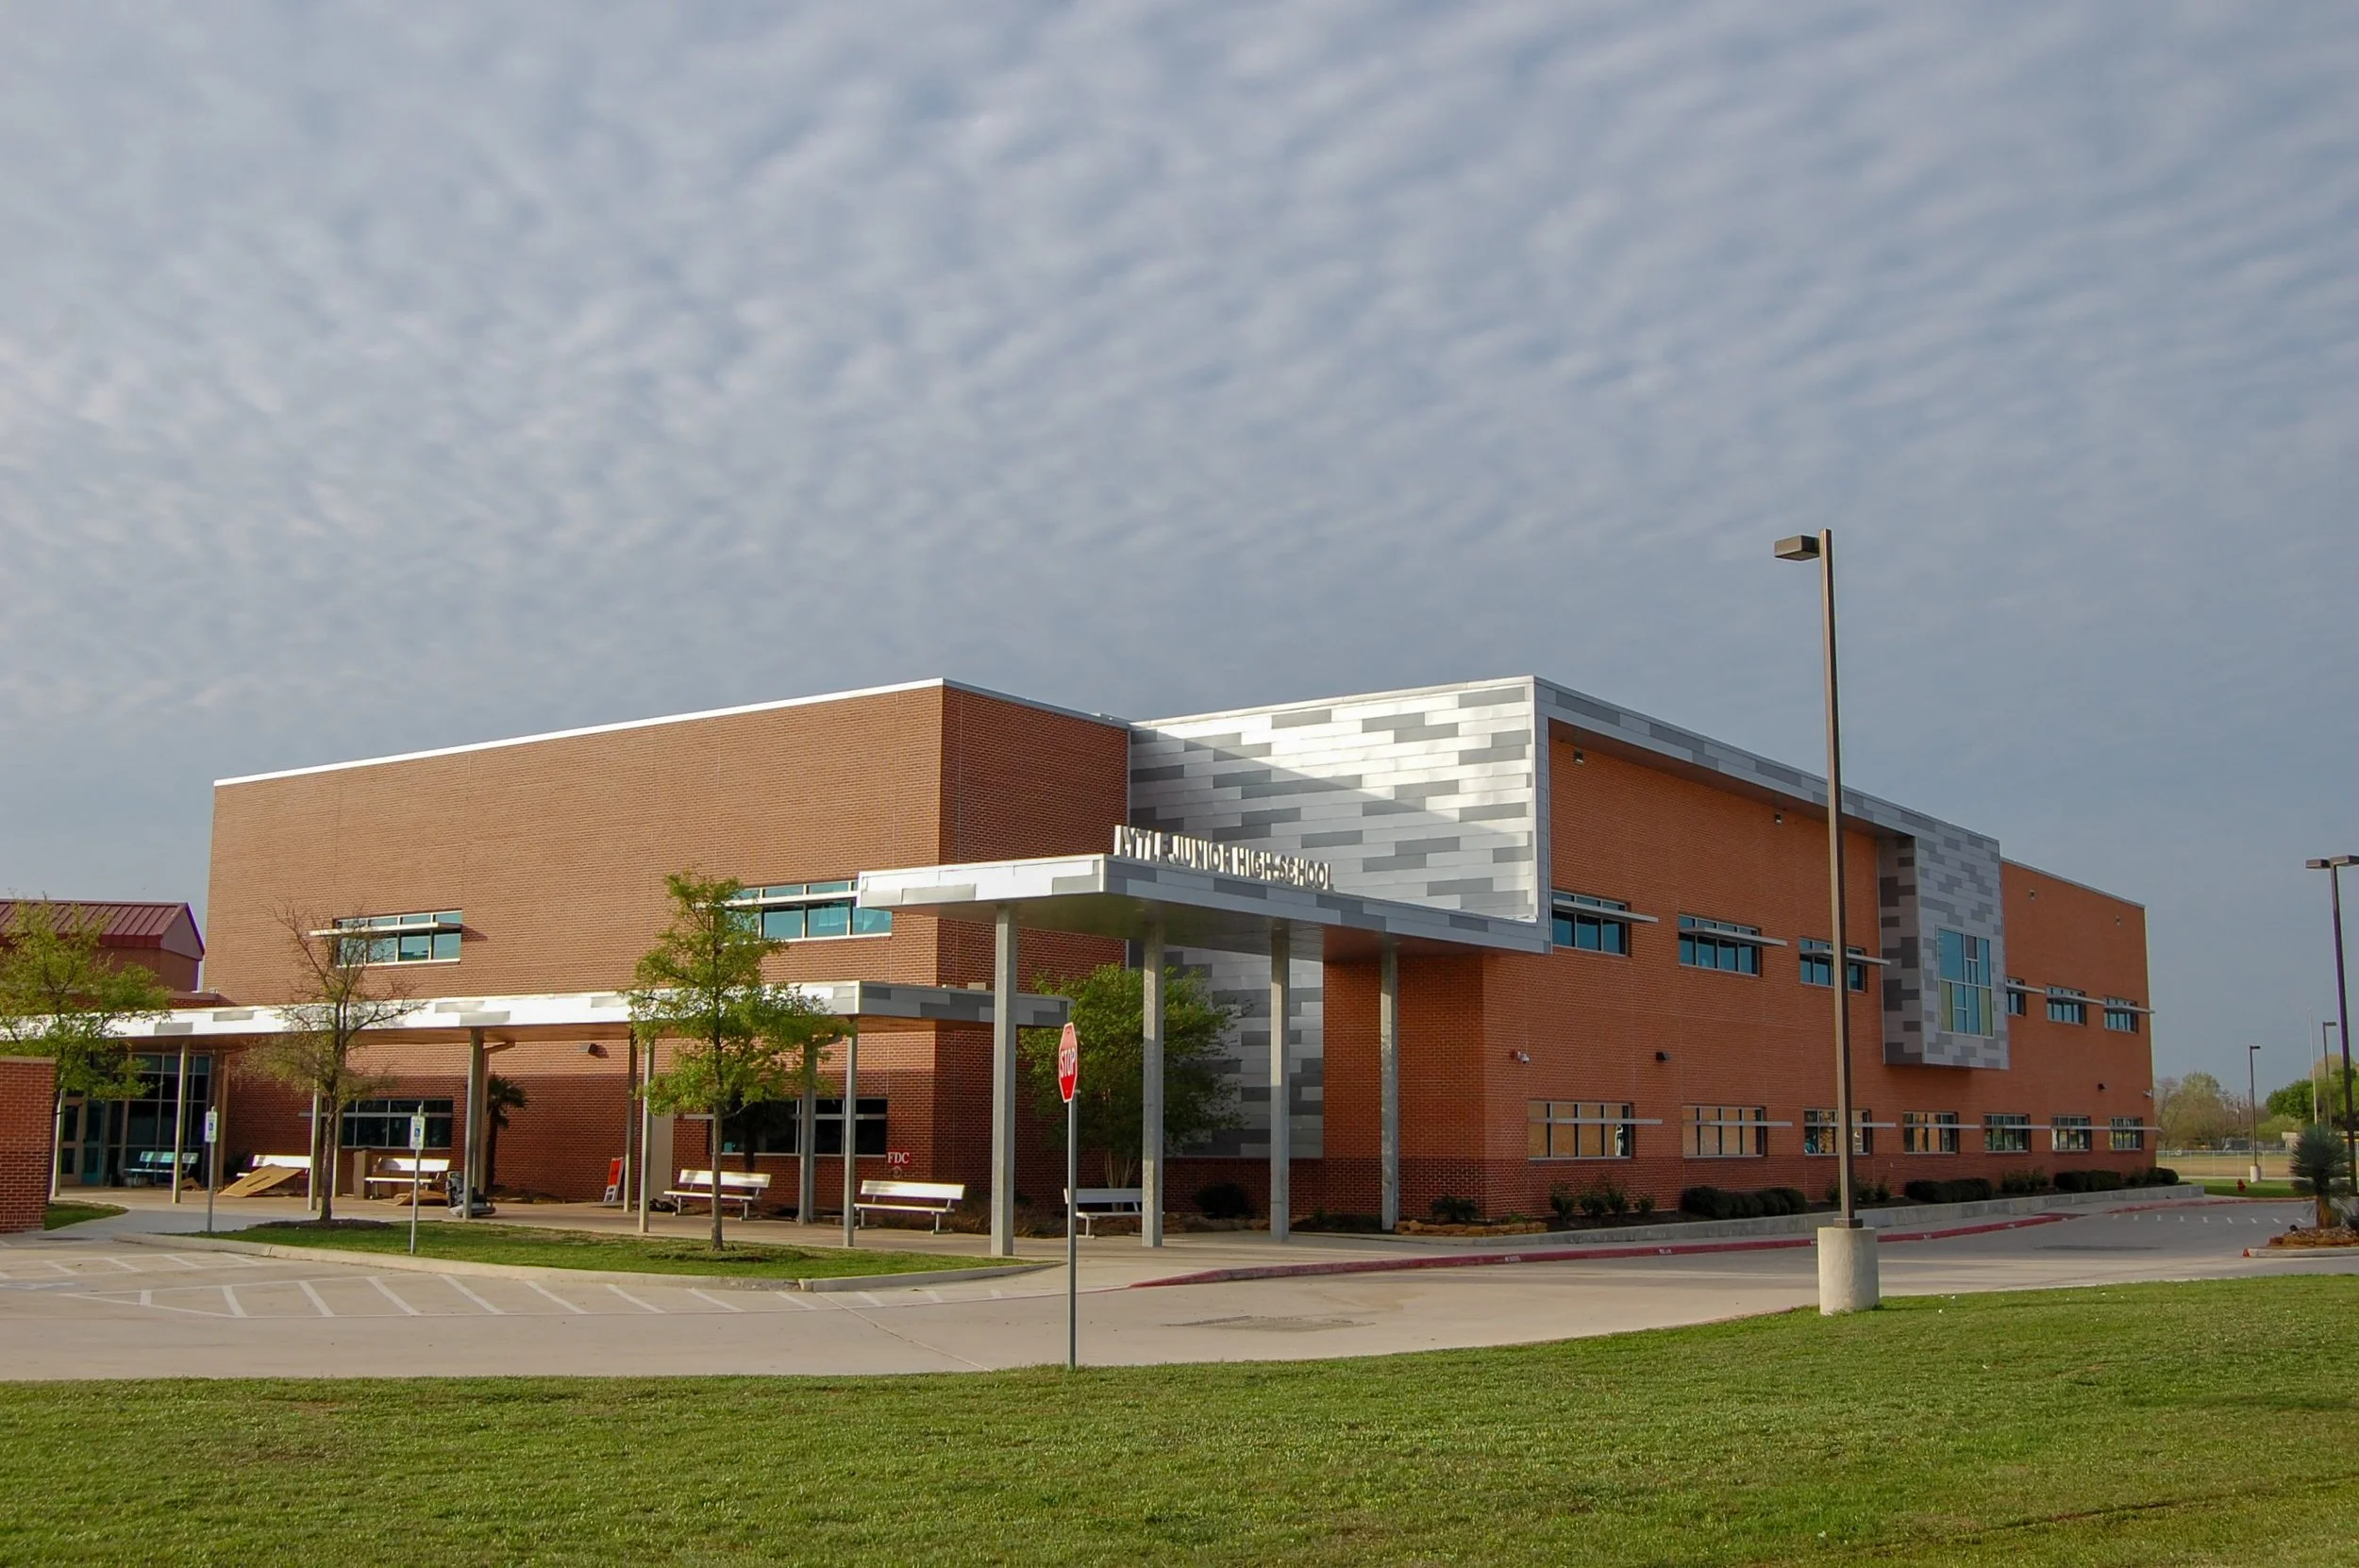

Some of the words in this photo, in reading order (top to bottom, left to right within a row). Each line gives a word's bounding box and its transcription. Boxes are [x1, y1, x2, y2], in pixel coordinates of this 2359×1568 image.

[1113, 825, 1171, 862] LYTLE
[1168, 835, 1230, 874] JUNIOR
[1231, 846, 1272, 881] HIGH
[1274, 853, 1331, 891] SCHOOL
[1059, 1047, 1076, 1078] STOP
[887, 1151, 910, 1164] FDC
